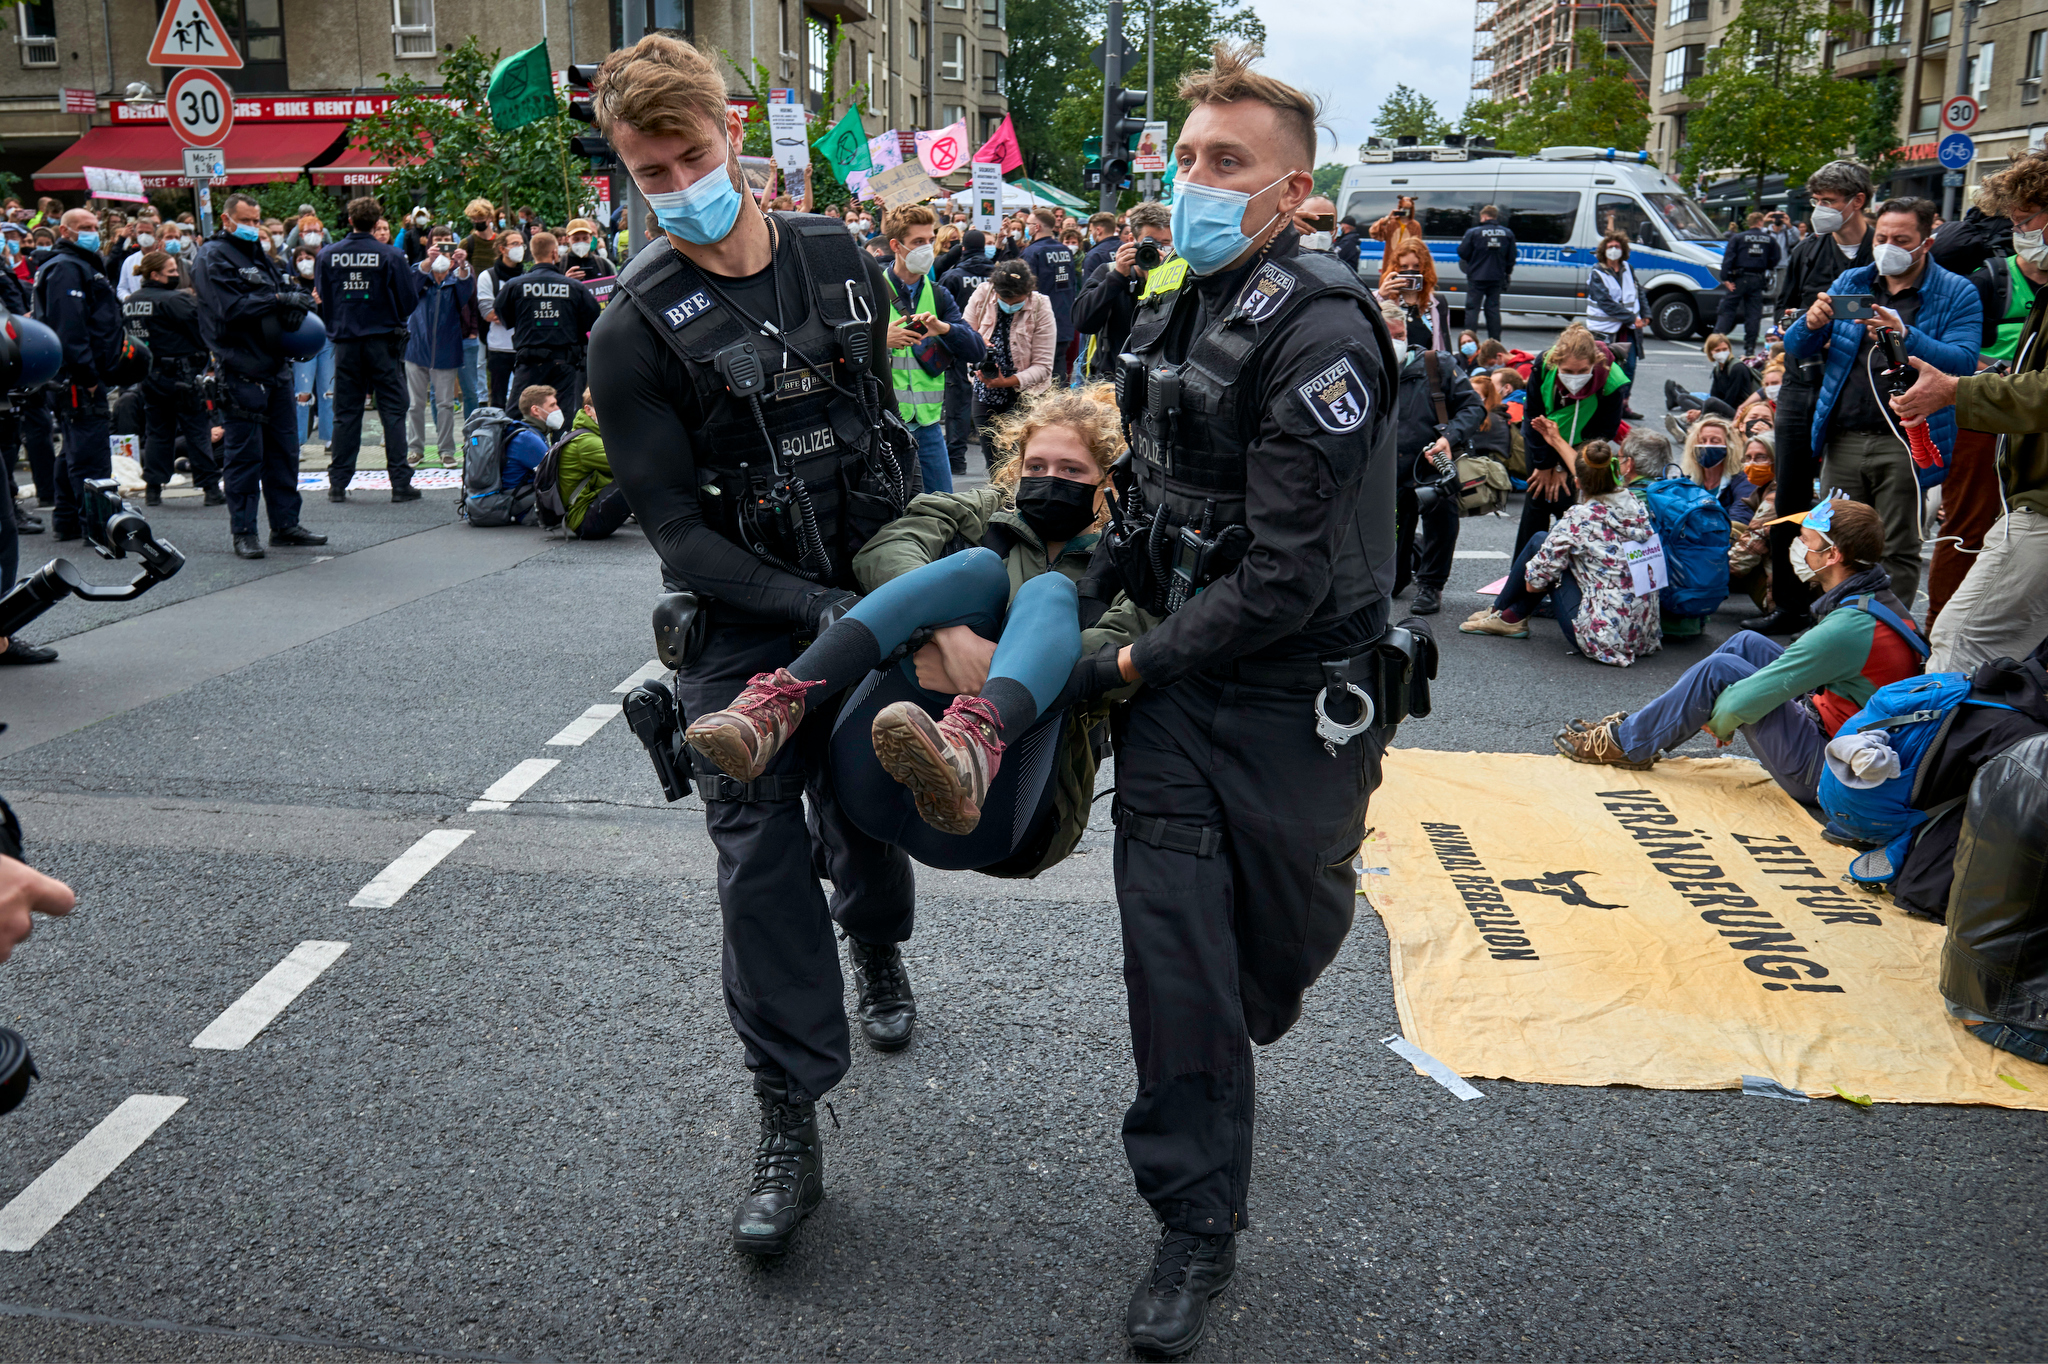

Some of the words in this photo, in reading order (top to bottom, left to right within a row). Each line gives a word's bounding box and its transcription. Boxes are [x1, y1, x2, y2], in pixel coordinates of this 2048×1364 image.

[181, 90, 219, 126] 30
[273, 101, 310, 117] BIKE
[313, 99, 375, 116] RENTAL
[1949, 104, 1973, 122] 30
[192, 152, 217, 163] Mo-Fr
[343, 173, 384, 185] BERLIN
[331, 253, 380, 268] POLIZEI
[342, 281, 370, 291] 31127
[349, 272, 363, 281] BE
[1260, 265, 1292, 291] POLIZEI
[523, 282, 570, 299] POLIZEI
[533, 309, 560, 319] 31124
[540, 301, 553, 311] BE
[665, 292, 710, 326] BFE
[1303, 361, 1350, 399] POLIZEI
[781, 426, 835, 456] POLIZEI
[1138, 433, 1170, 469] POLIZI
[1420, 821, 1487, 872] ANIMAL
[1731, 832, 1826, 879] ZEIT
[1779, 884, 1883, 927] FÜR
[1595, 789, 1846, 994] VERÄNDERUNG!
[1449, 873, 1541, 961] REBELLION
